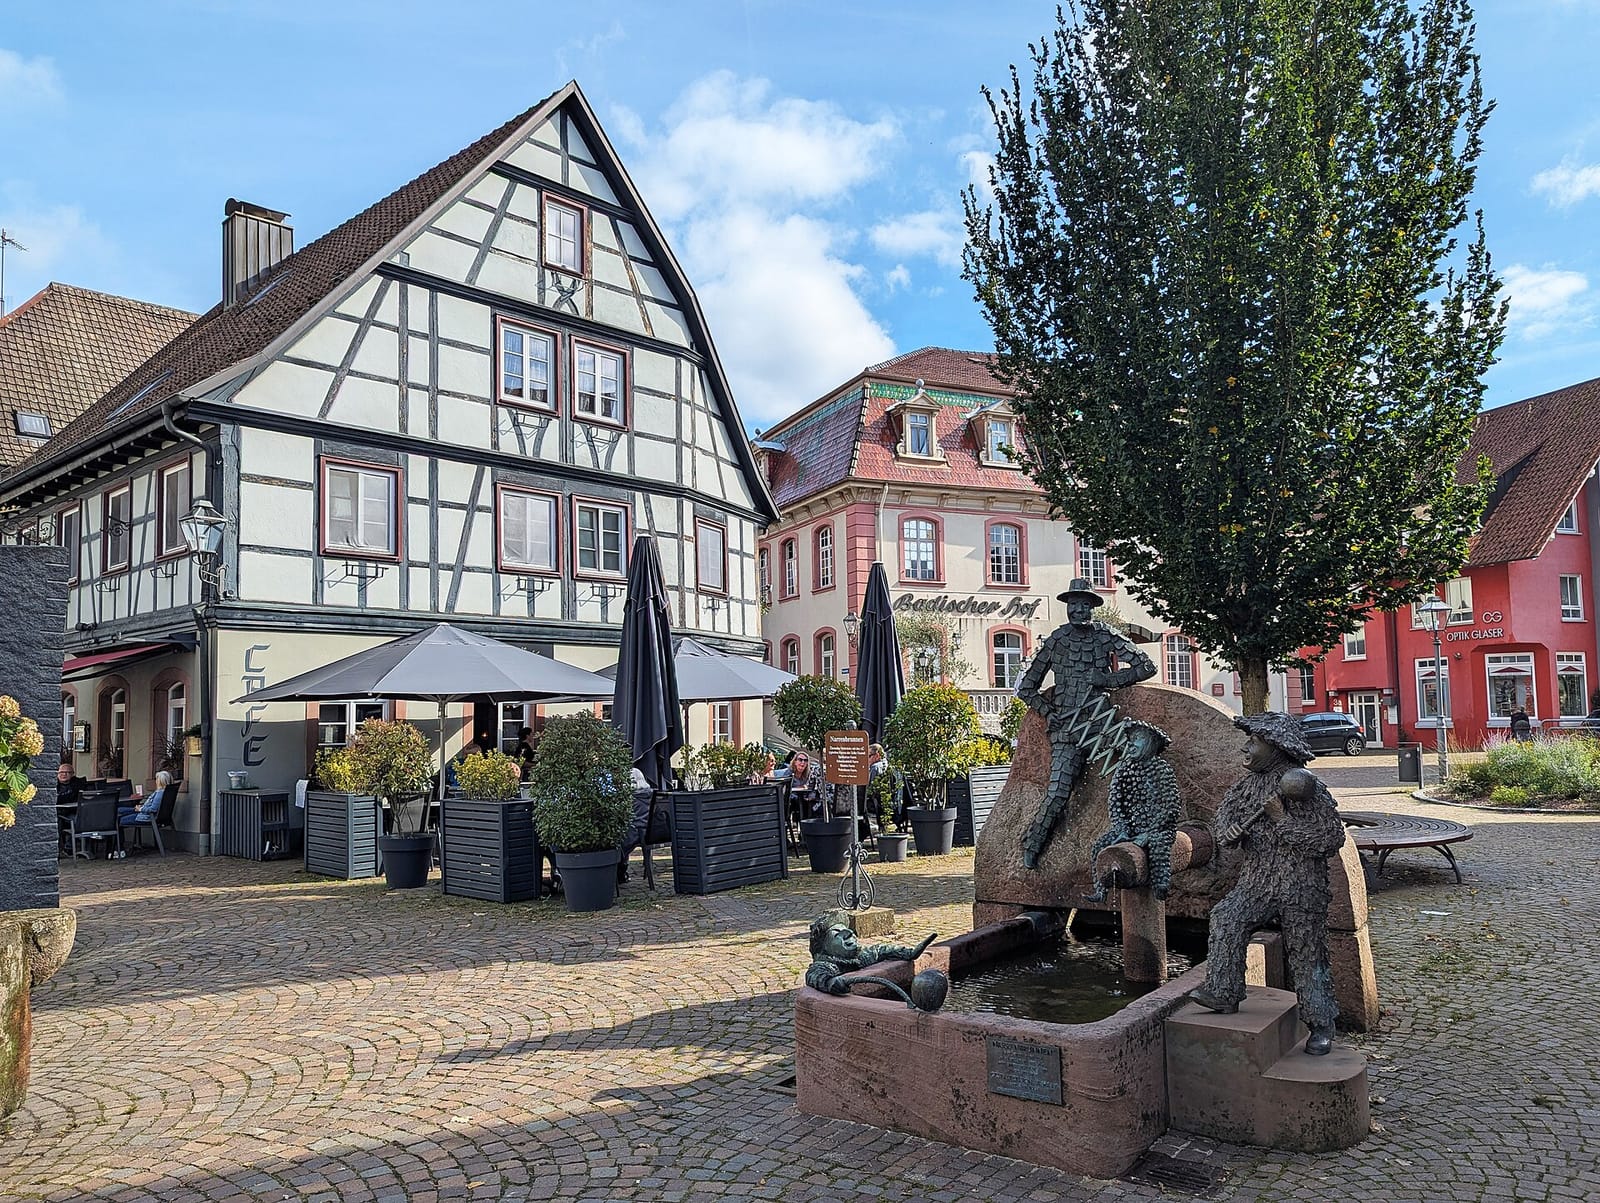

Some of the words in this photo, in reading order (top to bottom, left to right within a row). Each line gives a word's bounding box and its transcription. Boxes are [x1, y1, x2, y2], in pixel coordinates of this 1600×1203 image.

[893, 593, 1002, 615] Badischer
[1000, 596, 1042, 619] Hof
[1446, 631, 1470, 642] OPTIK
[1471, 628, 1504, 640] GLASER
